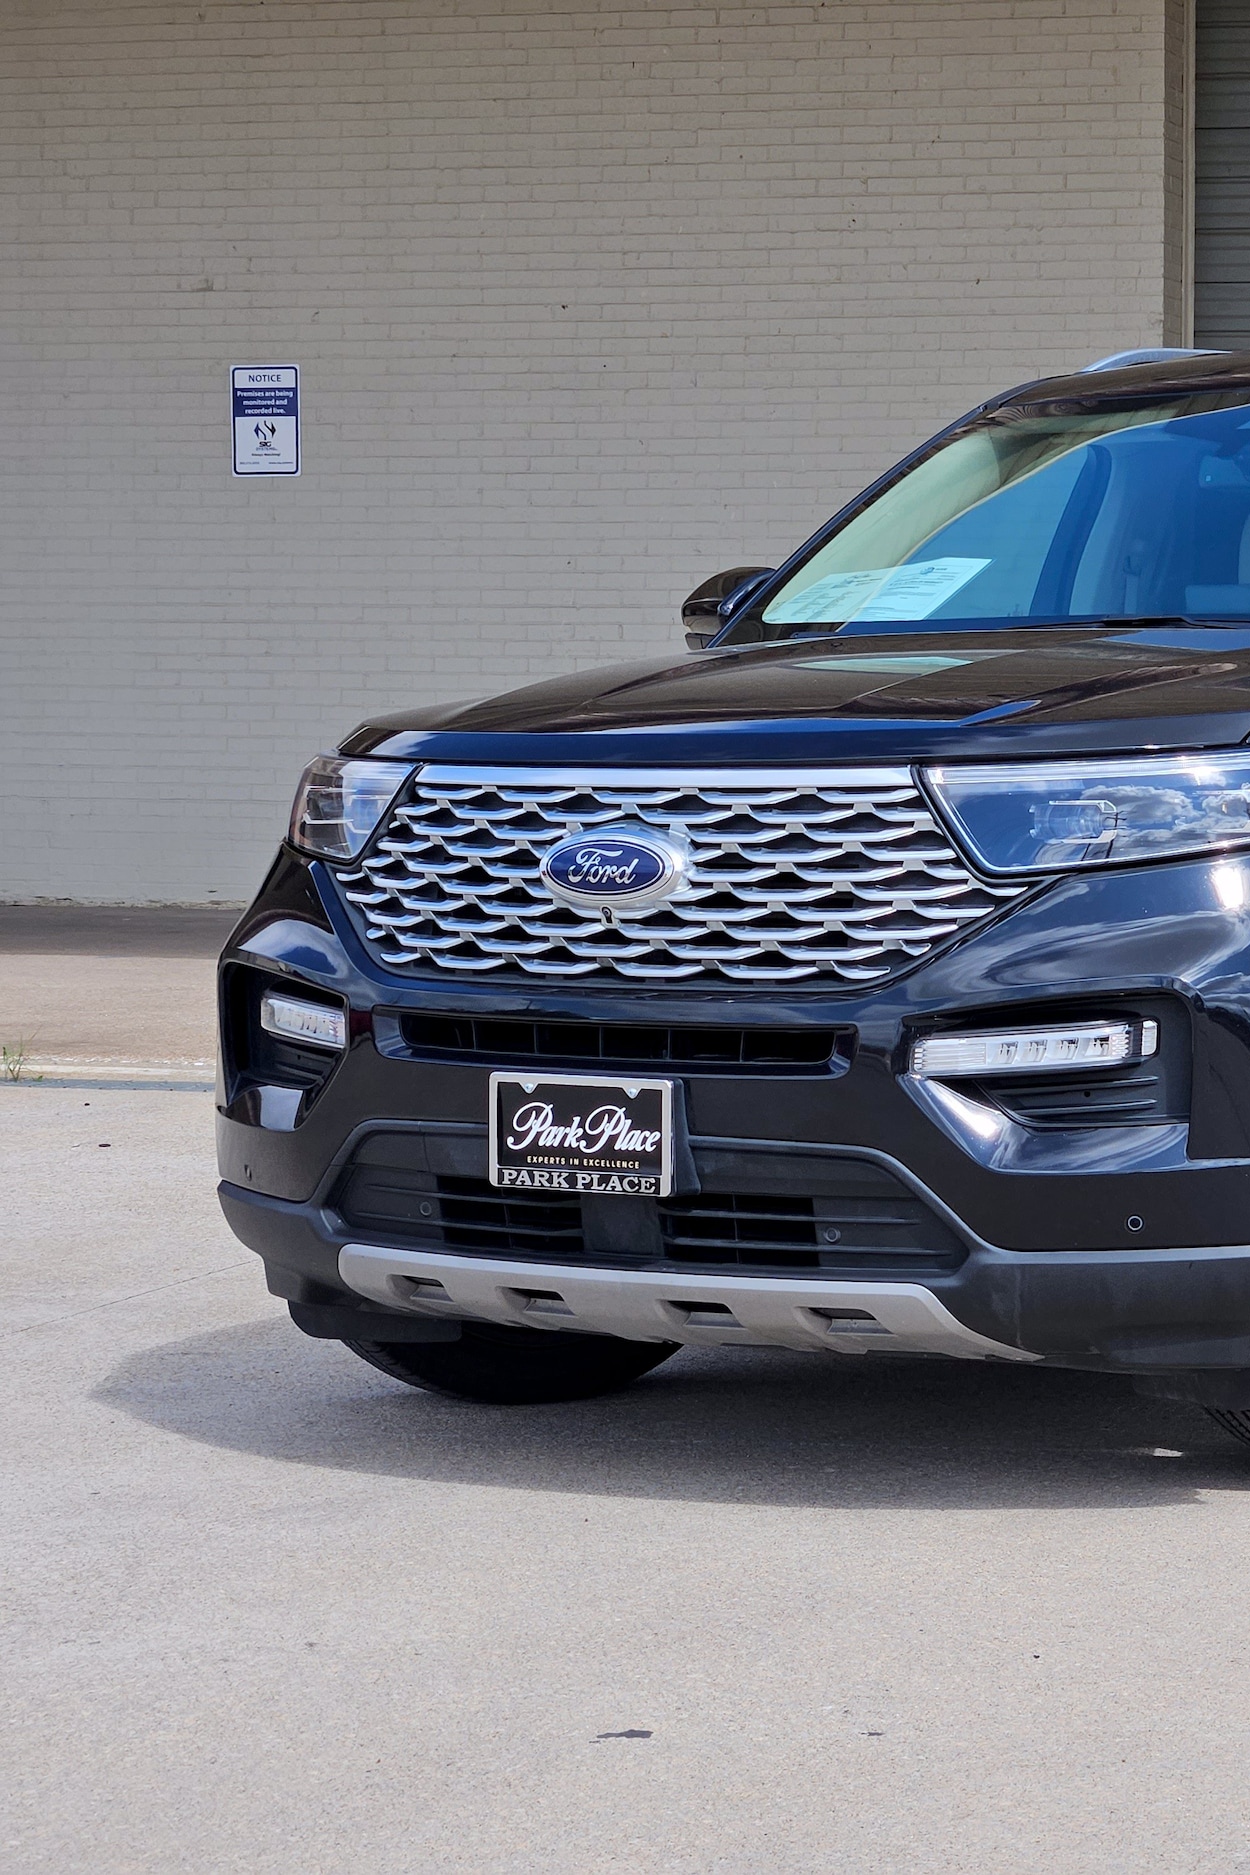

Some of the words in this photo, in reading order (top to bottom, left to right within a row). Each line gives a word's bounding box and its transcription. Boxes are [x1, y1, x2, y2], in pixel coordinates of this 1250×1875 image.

[248, 374, 282, 383] NOTICE
[275, 390, 293, 398] being
[568, 847, 640, 885] Ford
[506, 1101, 585, 1150] Park
[579, 1104, 662, 1154] Place
[526, 1155, 566, 1166] EXPERTS
[569, 1157, 580, 1166] IN
[582, 1158, 640, 1170] EXCELLENCE
[501, 1169, 570, 1190] PARK
[575, 1173, 656, 1194] PLACE
